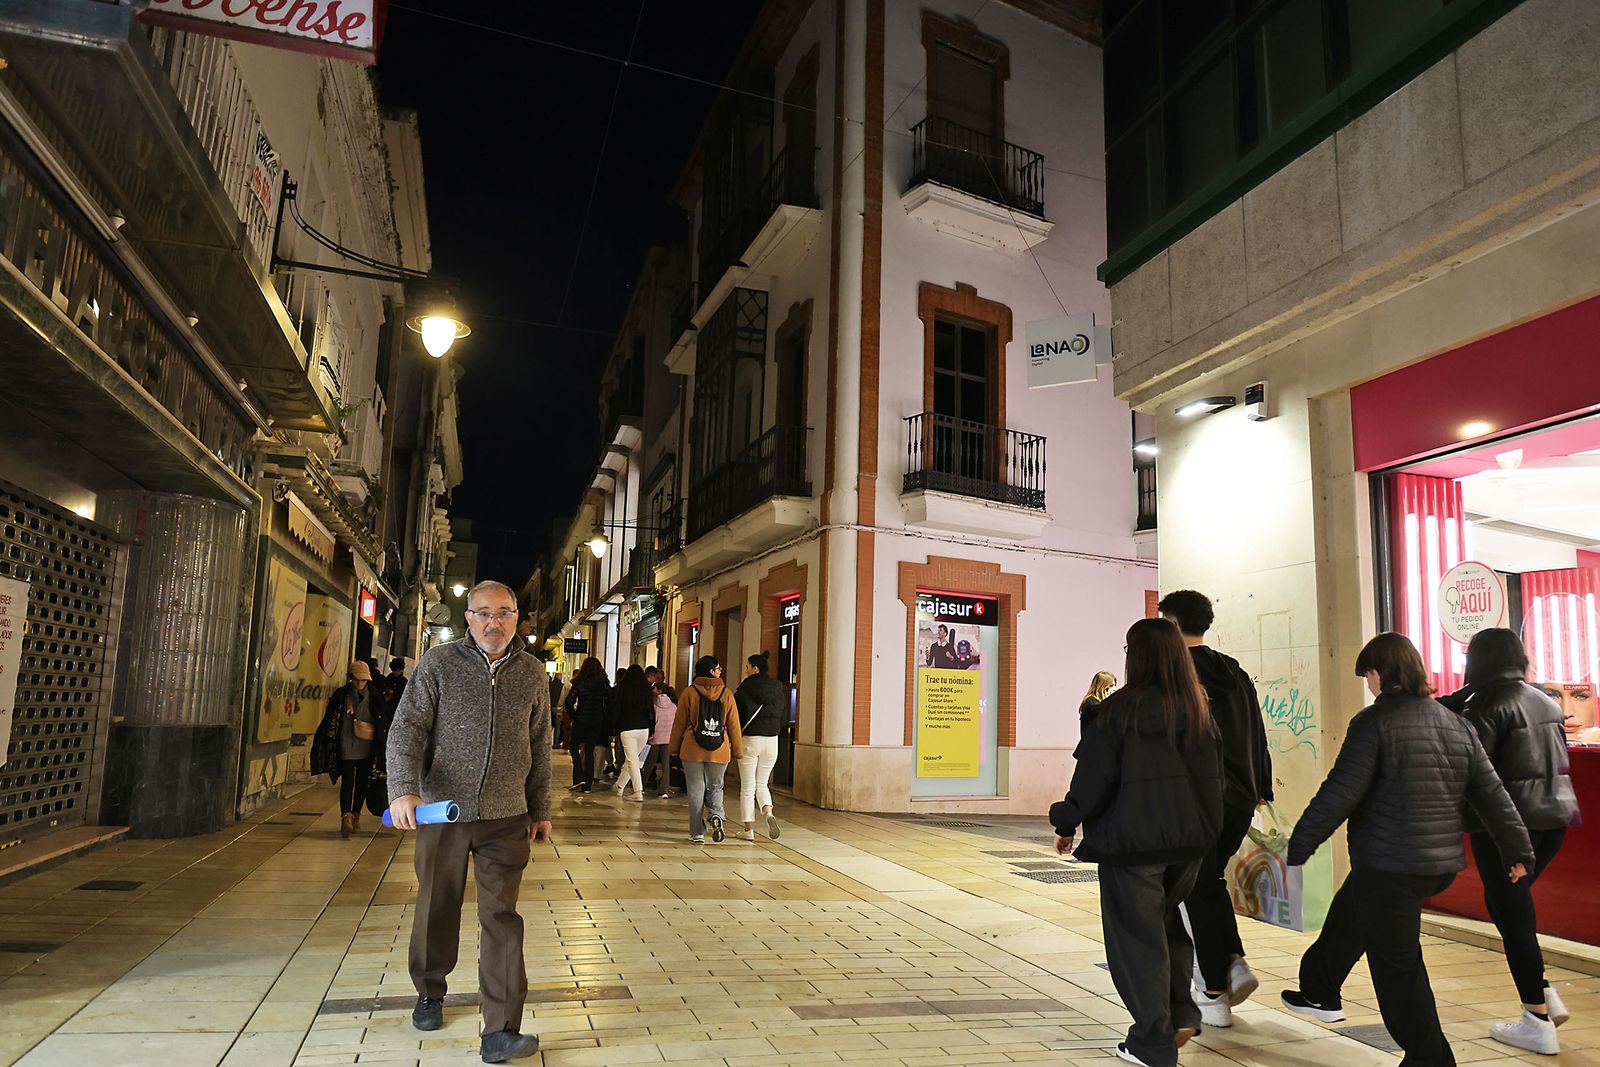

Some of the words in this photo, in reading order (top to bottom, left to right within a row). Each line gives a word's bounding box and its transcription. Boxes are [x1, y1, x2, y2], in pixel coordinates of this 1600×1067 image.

[1456, 578, 1486, 592] RECOGE
[1460, 586, 1492, 614] AQUÍ
[918, 598, 973, 617] cajasur
[1461, 615, 1484, 623] PEDIDO
[1457, 623, 1479, 631] ONLINE
[925, 675, 940, 684] Trae
[949, 676, 974, 685] nómina:
